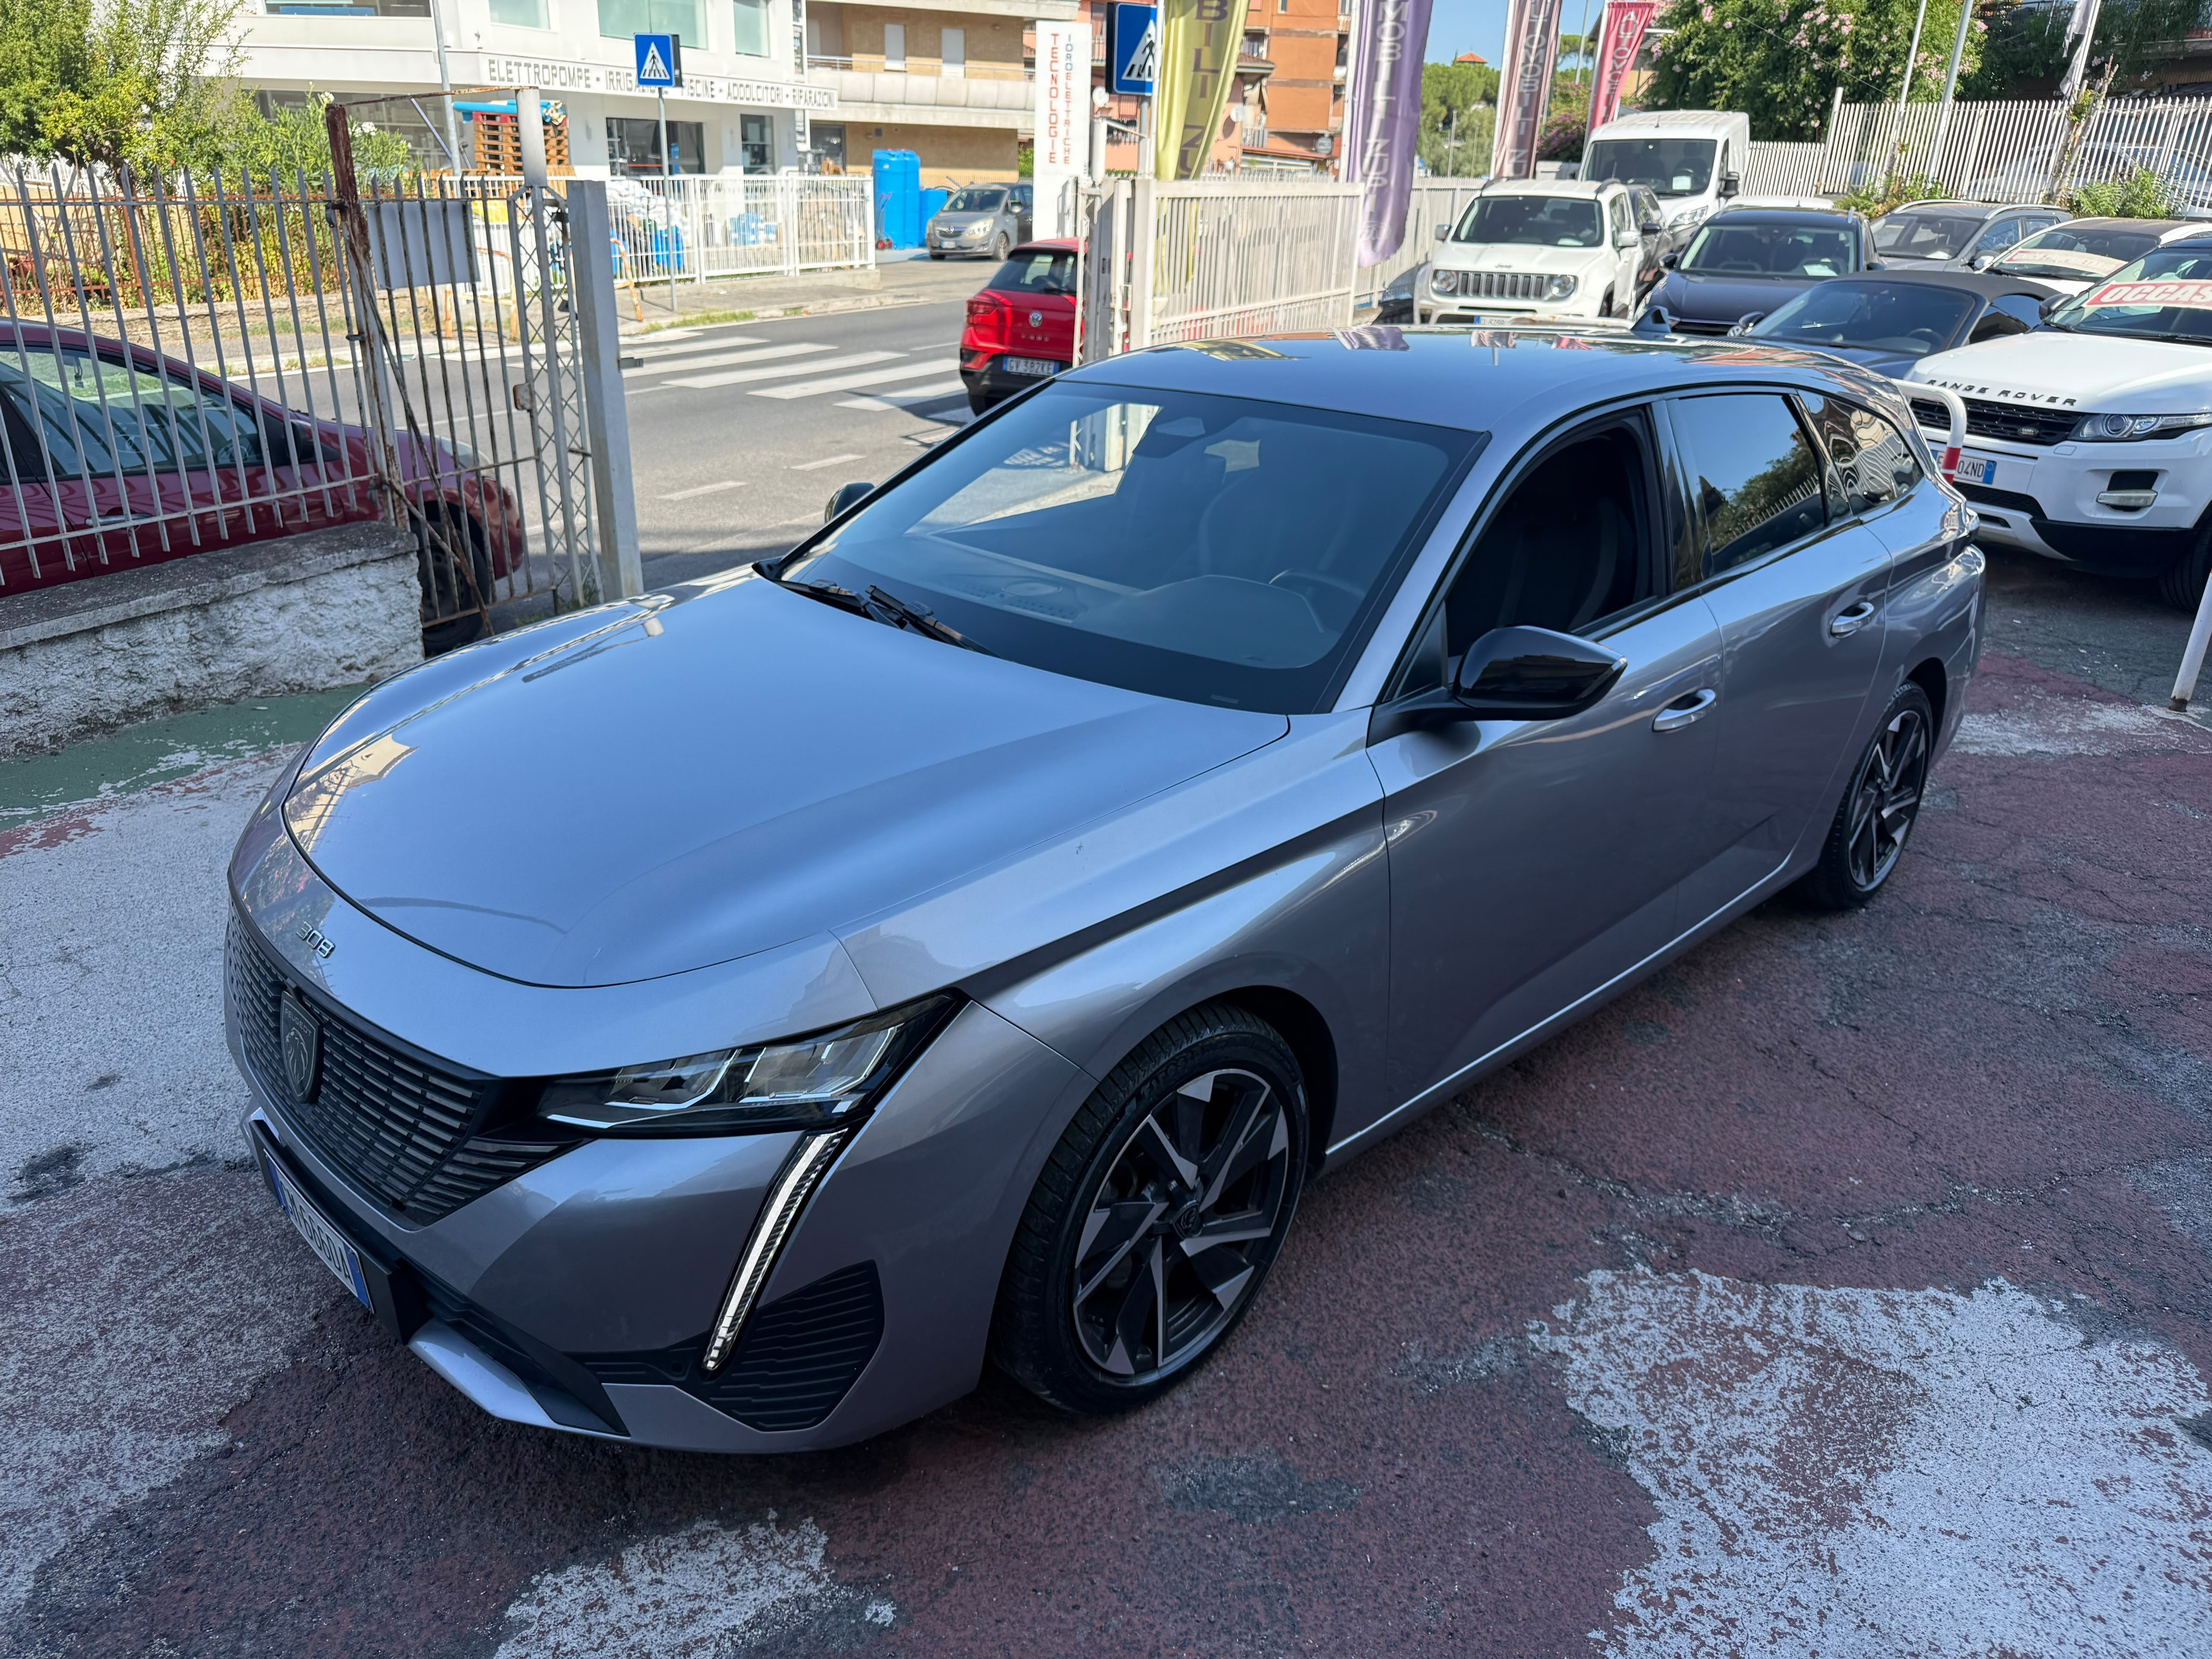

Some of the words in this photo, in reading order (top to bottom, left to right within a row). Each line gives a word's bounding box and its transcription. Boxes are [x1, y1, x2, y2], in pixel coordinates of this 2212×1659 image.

[488, 59, 591, 89] ELETTROPOMPE
[727, 82, 783, 104] ADDOLCITORI
[792, 88, 835, 108] RIPARAZIONI
[1516, 0, 1551, 135] UTOMOBILI
[1049, 33, 1059, 163] TECNOLOGIE
[1063, 34, 1073, 164] IDROELETTRICHE
[2100, 284, 2212, 303] OCCAS
[1926, 380, 1989, 394] RANGE
[1997, 390, 2077, 406] ROVER
[1957, 460, 1985, 478] 04ND
[296, 921, 336, 959] 308
[284, 1007, 312, 1037] PEUGEOT
